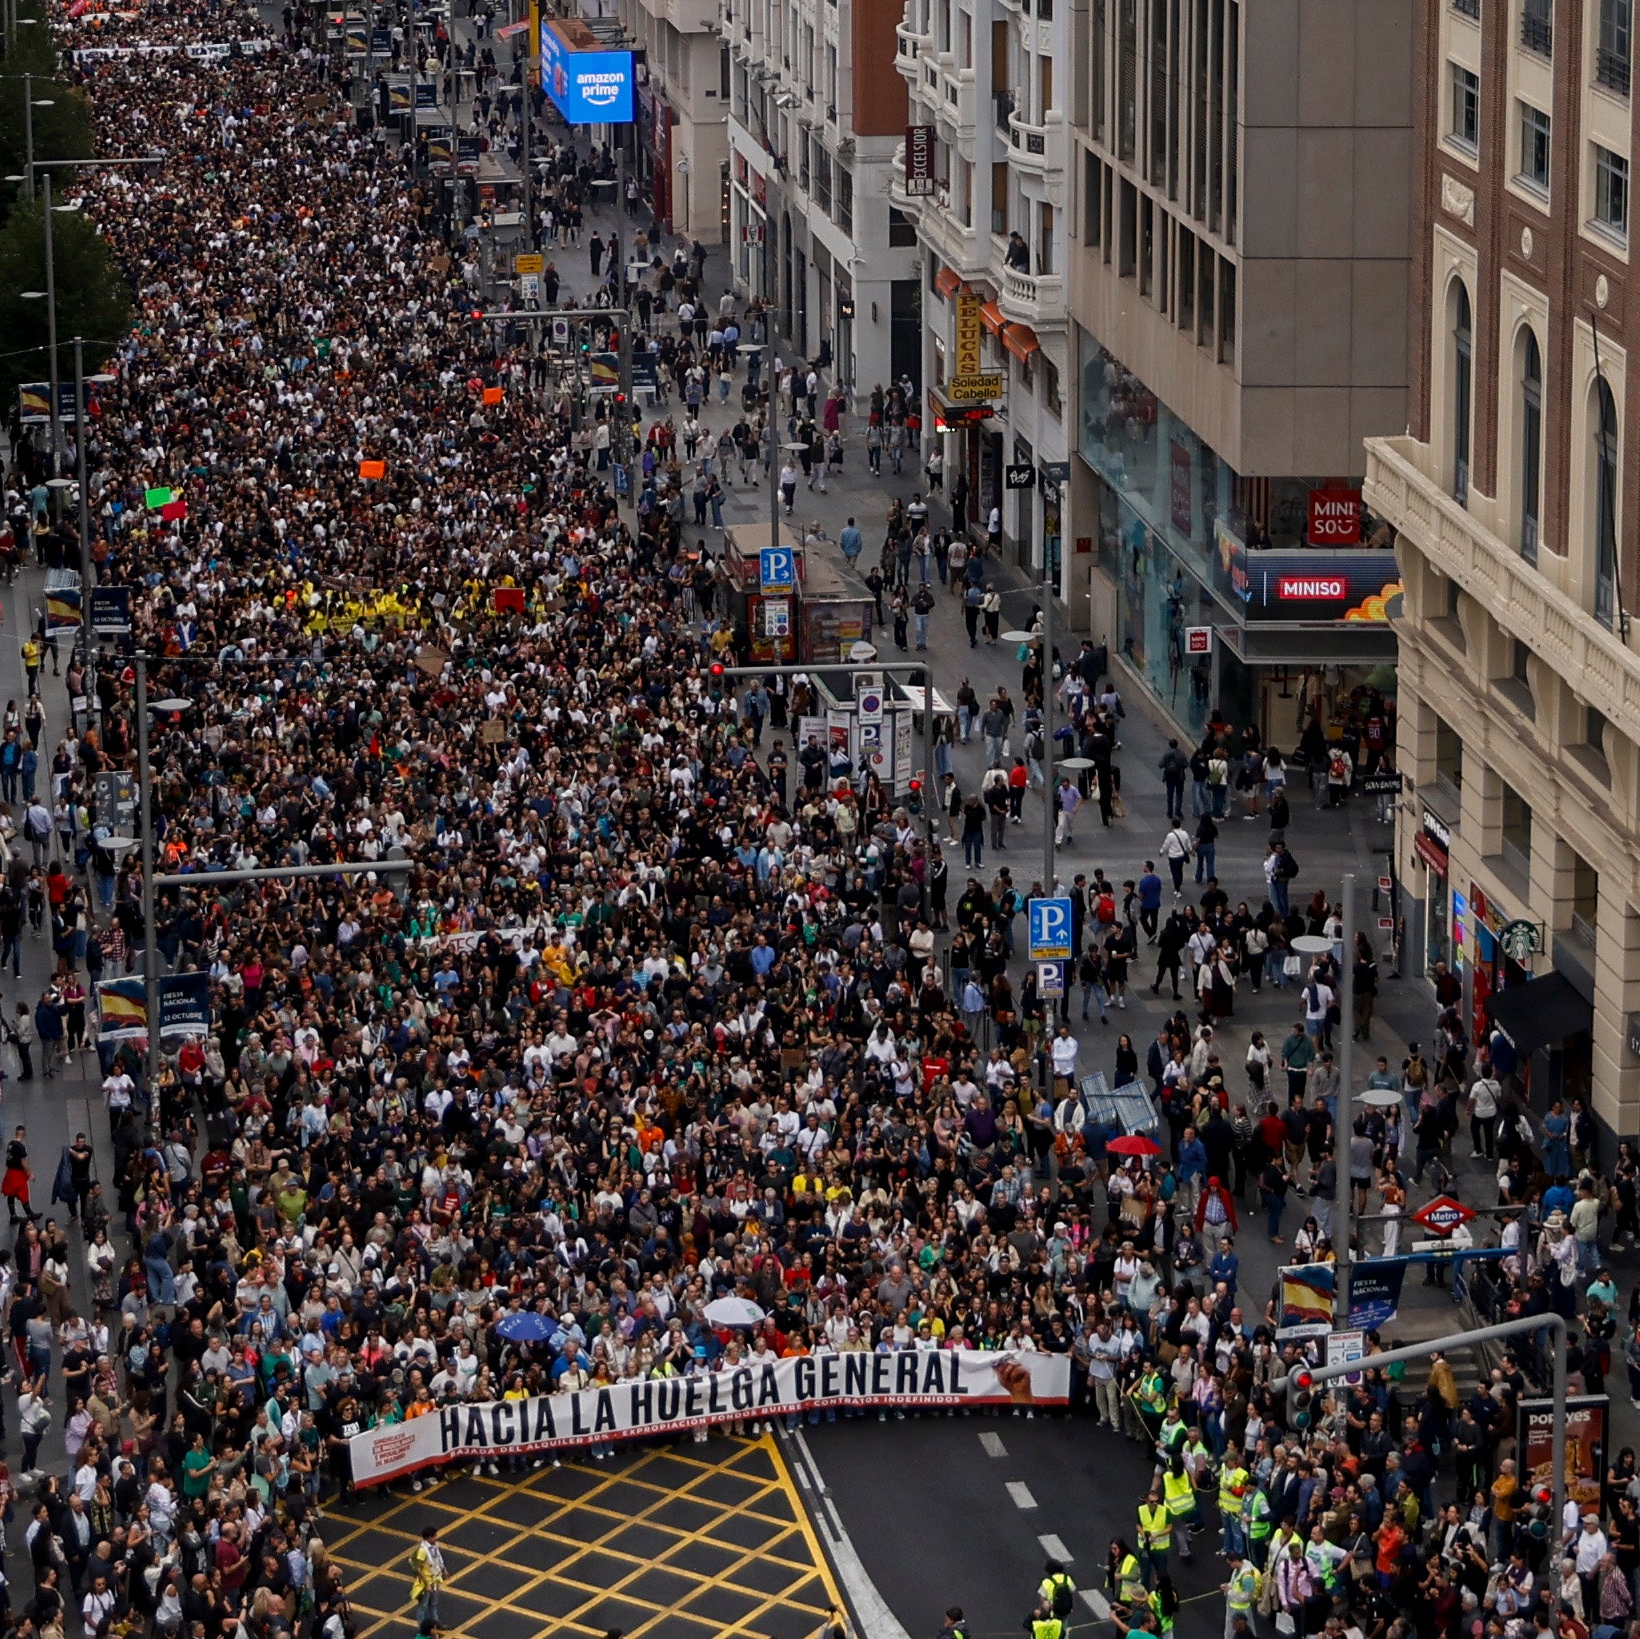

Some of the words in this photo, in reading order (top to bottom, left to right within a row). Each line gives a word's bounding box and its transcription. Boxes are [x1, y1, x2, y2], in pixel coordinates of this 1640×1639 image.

[577, 72, 625, 84] amazon
[582, 83, 619, 98] prime
[913, 127, 927, 179] EXCELSIOR
[960, 296, 977, 374] PELUCAS
[952, 375, 999, 388] Soledad
[953, 388, 997, 400] Cabello
[1314, 501, 1353, 516] MINI
[766, 552, 787, 580] P
[1283, 581, 1341, 596] MINISO
[1036, 905, 1064, 941] P
[1038, 963, 1059, 988] P
[1430, 1211, 1458, 1222] Metro
[1352, 1285, 1390, 1297] NACIONAL
[439, 1396, 557, 1453] HACIA
[570, 1387, 617, 1436] LA
[630, 1362, 781, 1427] HUELGA
[794, 1350, 970, 1401] GENERAL
[450, 1446, 495, 1458] BAJADA
[500, 1444, 522, 1454] DEL
[526, 1437, 585, 1452] ALQUILER
[622, 1416, 708, 1437] EXPROPIACIÓN
[710, 1409, 757, 1423] FONDOS
[761, 1402, 802, 1414] BUITRE
[813, 1395, 879, 1407] CONTRATOS
[883, 1395, 961, 1404] INDEFINIDOS
